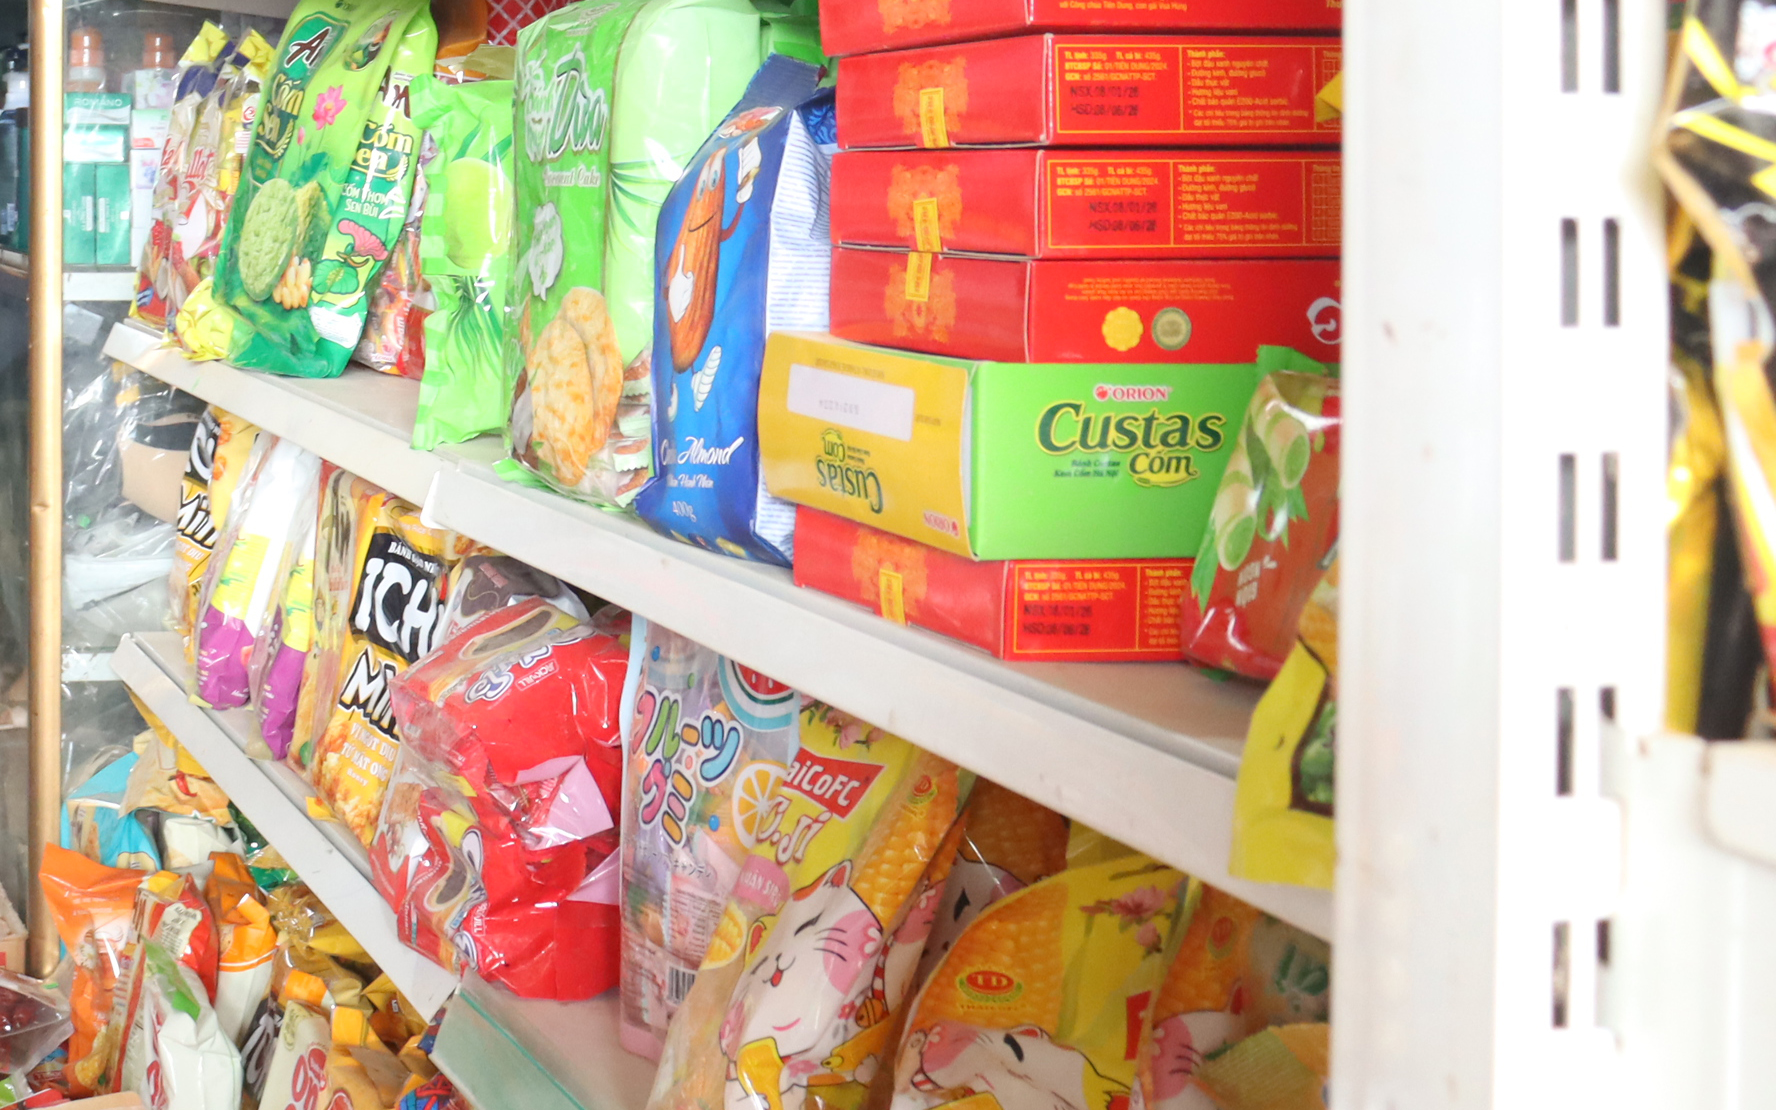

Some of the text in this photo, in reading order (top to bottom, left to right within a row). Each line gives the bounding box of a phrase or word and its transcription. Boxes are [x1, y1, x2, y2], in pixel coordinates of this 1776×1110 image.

[1112, 386, 1168, 401] ORION
[677, 436, 745, 465] Almond
[1036, 401, 1225, 454] Custas
[816, 458, 884, 515] Custas
[1128, 448, 1199, 478] Cốm
[387, 541, 412, 559] BÁNH
[631, 687, 743, 785] フルーツ
[640, 755, 697, 850] グミ
[784, 756, 862, 808] aiCoFC
